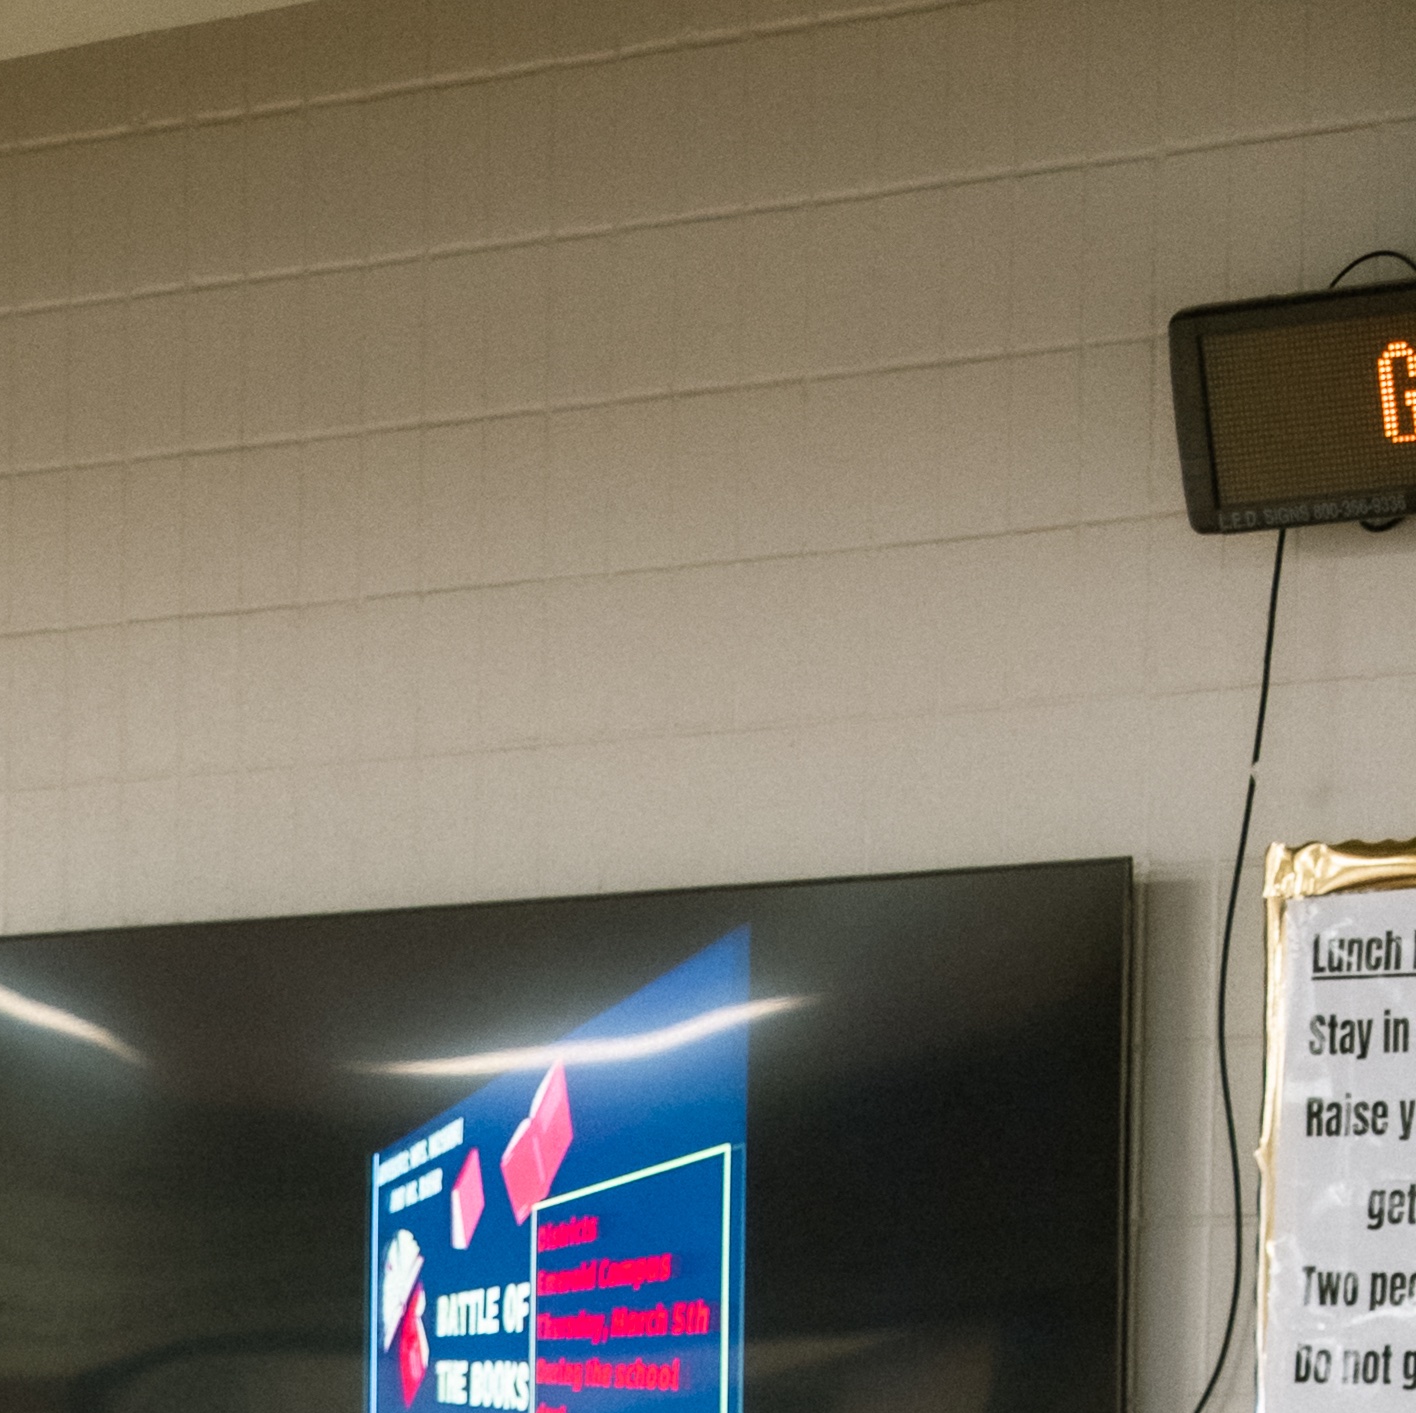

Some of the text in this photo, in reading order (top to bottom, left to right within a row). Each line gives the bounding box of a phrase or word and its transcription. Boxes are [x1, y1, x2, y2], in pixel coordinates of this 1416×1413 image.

[1262, 504, 1310, 526] SIGNS
[1312, 929, 1403, 974] Lunch
[1308, 1008, 1410, 1060] Stay in
[1305, 1092, 1389, 1138] Raise
[598, 1252, 673, 1291] Campus
[1301, 1265, 1359, 1307] Two
[435, 1281, 531, 1338] BATTLE OF
[610, 1302, 669, 1338] March
[671, 1299, 711, 1336] 5th
[585, 1356, 612, 1388] the
[614, 1356, 681, 1392] school
[1293, 1343, 1332, 1384] Do
[1341, 1344, 1392, 1385] not
[435, 1359, 531, 1412] THE BOOKS
